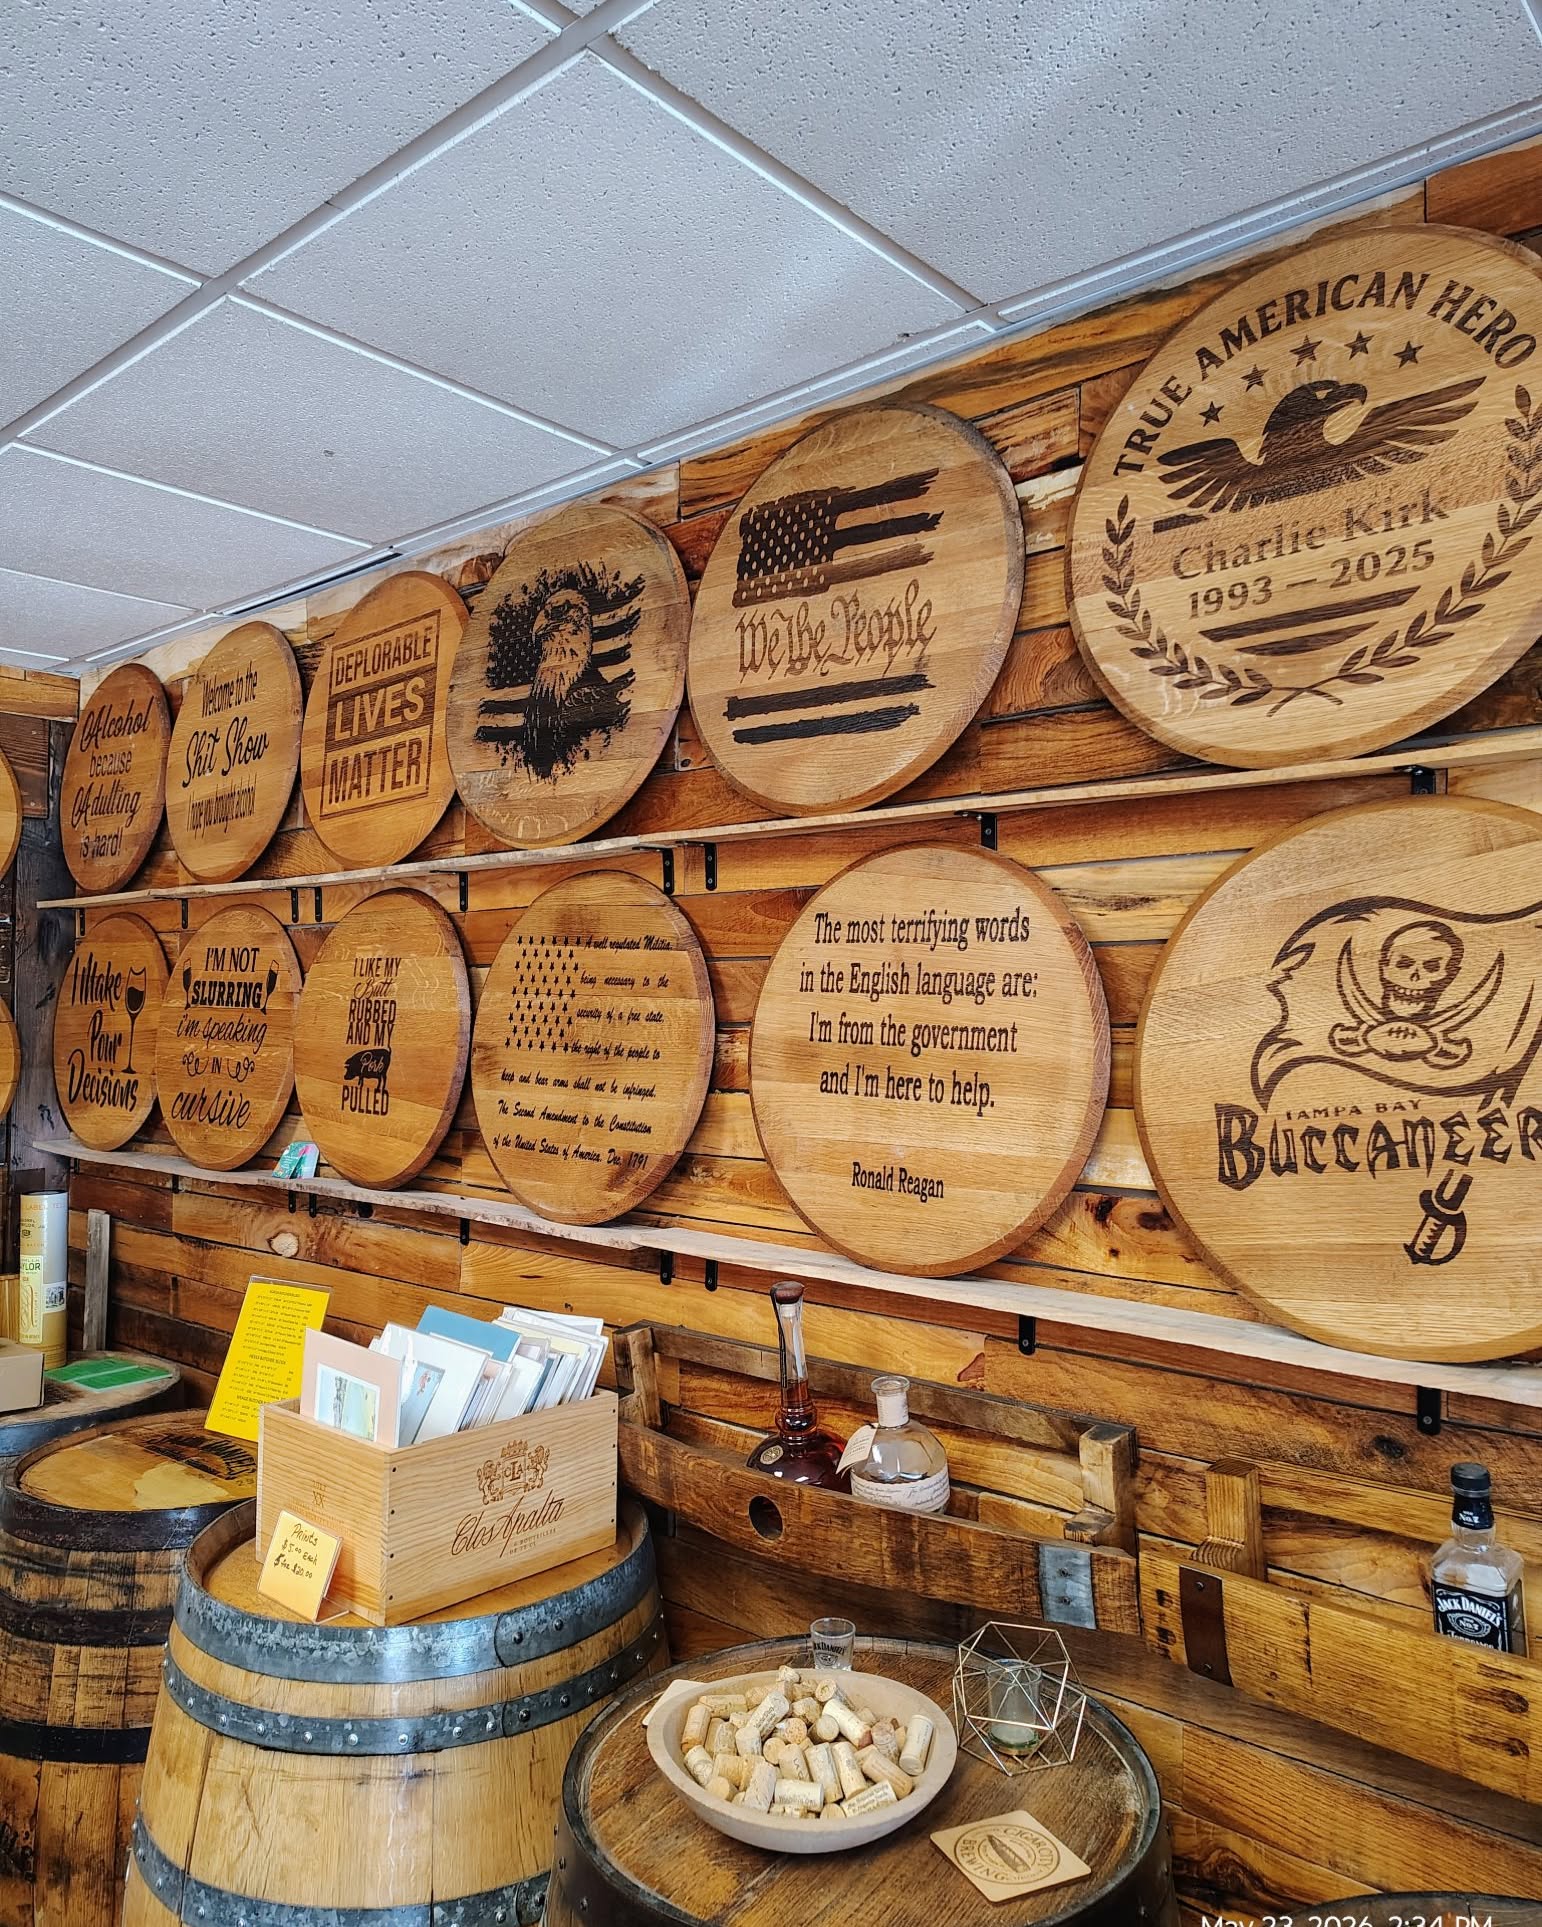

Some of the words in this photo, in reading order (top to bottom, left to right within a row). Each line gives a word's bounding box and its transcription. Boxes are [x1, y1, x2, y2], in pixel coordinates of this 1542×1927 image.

[1113, 375, 1194, 477] TRUE
[1195, 271, 1431, 382] AMERICAN
[1426, 279, 1537, 369] HERO
[1172, 520, 1326, 580] Charlie
[1342, 486, 1449, 542] Kirk
[1189, 575, 1273, 620] 1993
[1329, 538, 1435, 589] 2025
[735, 608, 785, 684] We
[771, 601, 831, 678] the
[820, 579, 937, 678] People
[335, 626, 433, 687] DEPLORABLE
[202, 673, 234, 718] Welcome
[235, 671, 243, 706] to
[245, 660, 258, 703] the
[335, 676, 426, 741] LIVES
[80, 695, 154, 752] Alcohol
[89, 751, 132, 777] because
[182, 727, 221, 788] Shit
[221, 716, 269, 777] Show
[329, 737, 424, 805] MATTER
[71, 779, 142, 828] Adulting
[190, 791, 204, 840] hope
[202, 798, 214, 838] you
[214, 779, 236, 834] brought
[79, 831, 90, 858] is
[91, 827, 123, 858] hard!
[814, 911, 842, 944] The
[845, 913, 886, 943] most
[891, 908, 970, 951] terrifying
[975, 906, 1031, 942] words
[204, 947, 226, 972] I'M
[228, 947, 260, 972] NOT
[353, 957, 358, 977] I
[360, 957, 381, 978] LIKE
[383, 957, 401, 978] MY
[580, 969, 597, 989] being
[603, 976, 636, 990] necessary
[642, 976, 650, 987] to
[657, 973, 669, 988] the
[72, 957, 80, 1006] I
[79, 952, 122, 1012] Make
[191, 980, 263, 1008] SLURRING
[353, 976, 394, 1000] Butt
[799, 961, 814, 992] in
[819, 961, 845, 993] the
[849, 961, 911, 1002] English
[915, 961, 996, 1005] language
[348, 998, 397, 1025] RUBBED
[576, 1008, 602, 1023] security
[606, 1006, 615, 1024] of
[617, 1011, 623, 1020] a
[626, 1007, 641, 1025] free
[87, 1009, 122, 1064] Pour
[202, 1013, 268, 1055] speaking
[346, 1022, 370, 1046] AND
[373, 1023, 395, 1048] MY
[571, 1039, 582, 1054] the
[584, 1040, 601, 1059] right
[603, 1042, 612, 1060] of
[613, 1041, 625, 1057] the
[626, 1043, 650, 1061] people
[652, 1048, 661, 1060] to
[809, 1011, 833, 1042] I'm
[838, 1011, 874, 1045] from
[880, 1013, 907, 1047] the
[911, 1021, 1018, 1058] government
[67, 1048, 139, 1112] Decisions
[211, 1057, 222, 1074] IN
[360, 1052, 385, 1073] Pork
[341, 1085, 389, 1116] PULLED
[501, 1068, 515, 1086] keep
[518, 1071, 532, 1084] and
[534, 1070, 548, 1086] bear
[552, 1077, 568, 1088] arms
[572, 1075, 591, 1090] shall
[594, 1081, 607, 1093] not
[610, 1078, 618, 1094] be
[622, 1082, 657, 1101] infringed.
[819, 1062, 850, 1095] and
[854, 1063, 880, 1097] I'm
[885, 1065, 922, 1101] here
[928, 1072, 945, 1104] to
[950, 1069, 995, 1117] help.
[171, 1088, 251, 1129] cursive
[498, 1099, 509, 1115] The
[513, 1101, 536, 1118] Second
[539, 1105, 579, 1125] Amendment
[582, 1114, 590, 1126] to
[593, 1113, 605, 1128] the
[608, 1114, 652, 1134] Constitution
[1286, 1105, 1363, 1121] TAMPA
[1375, 1099, 1422, 1114] BAY
[492, 1133, 501, 1149] of
[501, 1134, 512, 1148] the
[514, 1134, 538, 1151] United
[538, 1137, 560, 1155] States
[562, 1144, 571, 1160] of
[626, 1151, 649, 1169] 1791
[851, 1161, 894, 1191] Ronald
[897, 1167, 944, 1203] Reagan
[291, 1523, 318, 1547] Prints
[452, 1511, 497, 1556] Clos
[497, 1489, 565, 1558] Apalta
[1436, 1597, 1462, 1613] JACK
[1461, 1596, 1502, 1628] DANIEL'S
[960, 1838, 1009, 1881] BREWING
[1004, 1827, 1045, 1850] CIGAR
